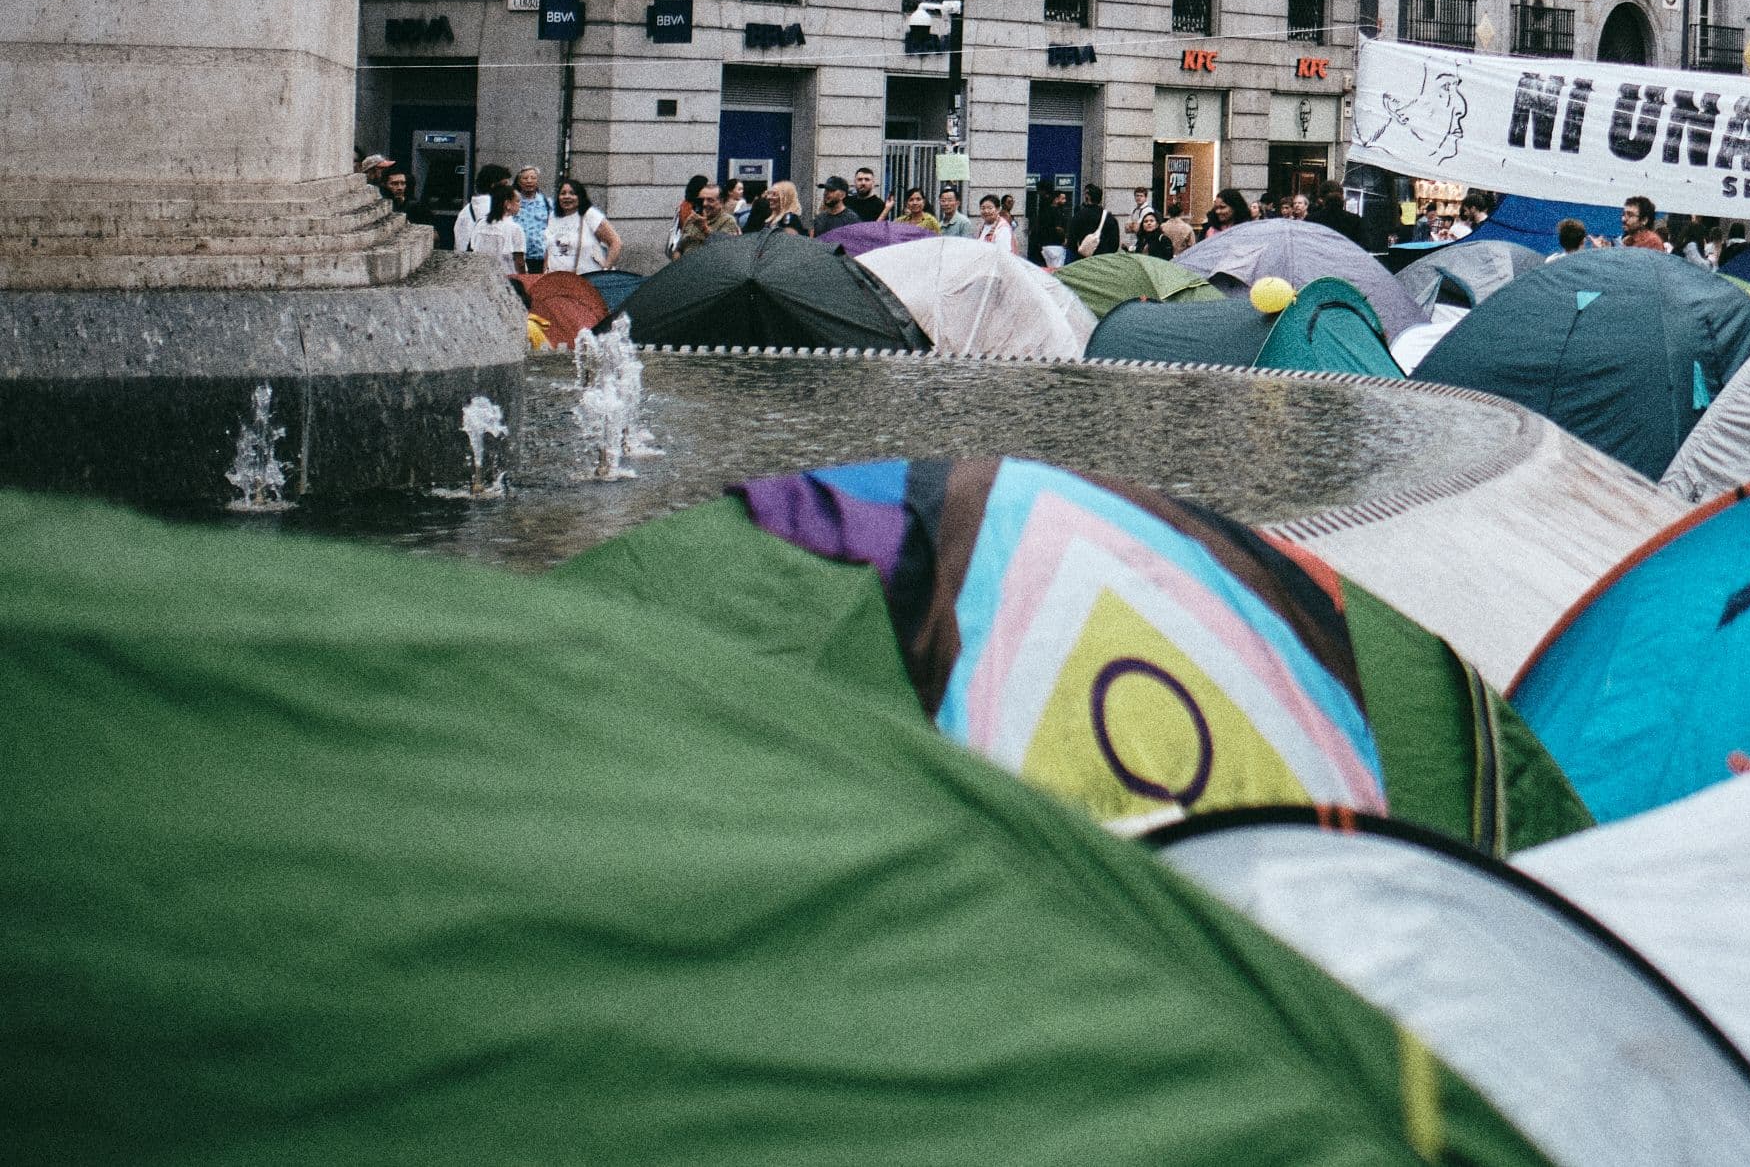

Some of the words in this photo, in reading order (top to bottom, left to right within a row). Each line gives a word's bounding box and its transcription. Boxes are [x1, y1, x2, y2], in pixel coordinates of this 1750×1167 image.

[546, 11, 575, 23] BBVA
[656, 15, 685, 26] BBVA
[1182, 50, 1219, 72] KFC
[1297, 57, 1329, 79] KFC
[1507, 71, 1595, 154] NI
